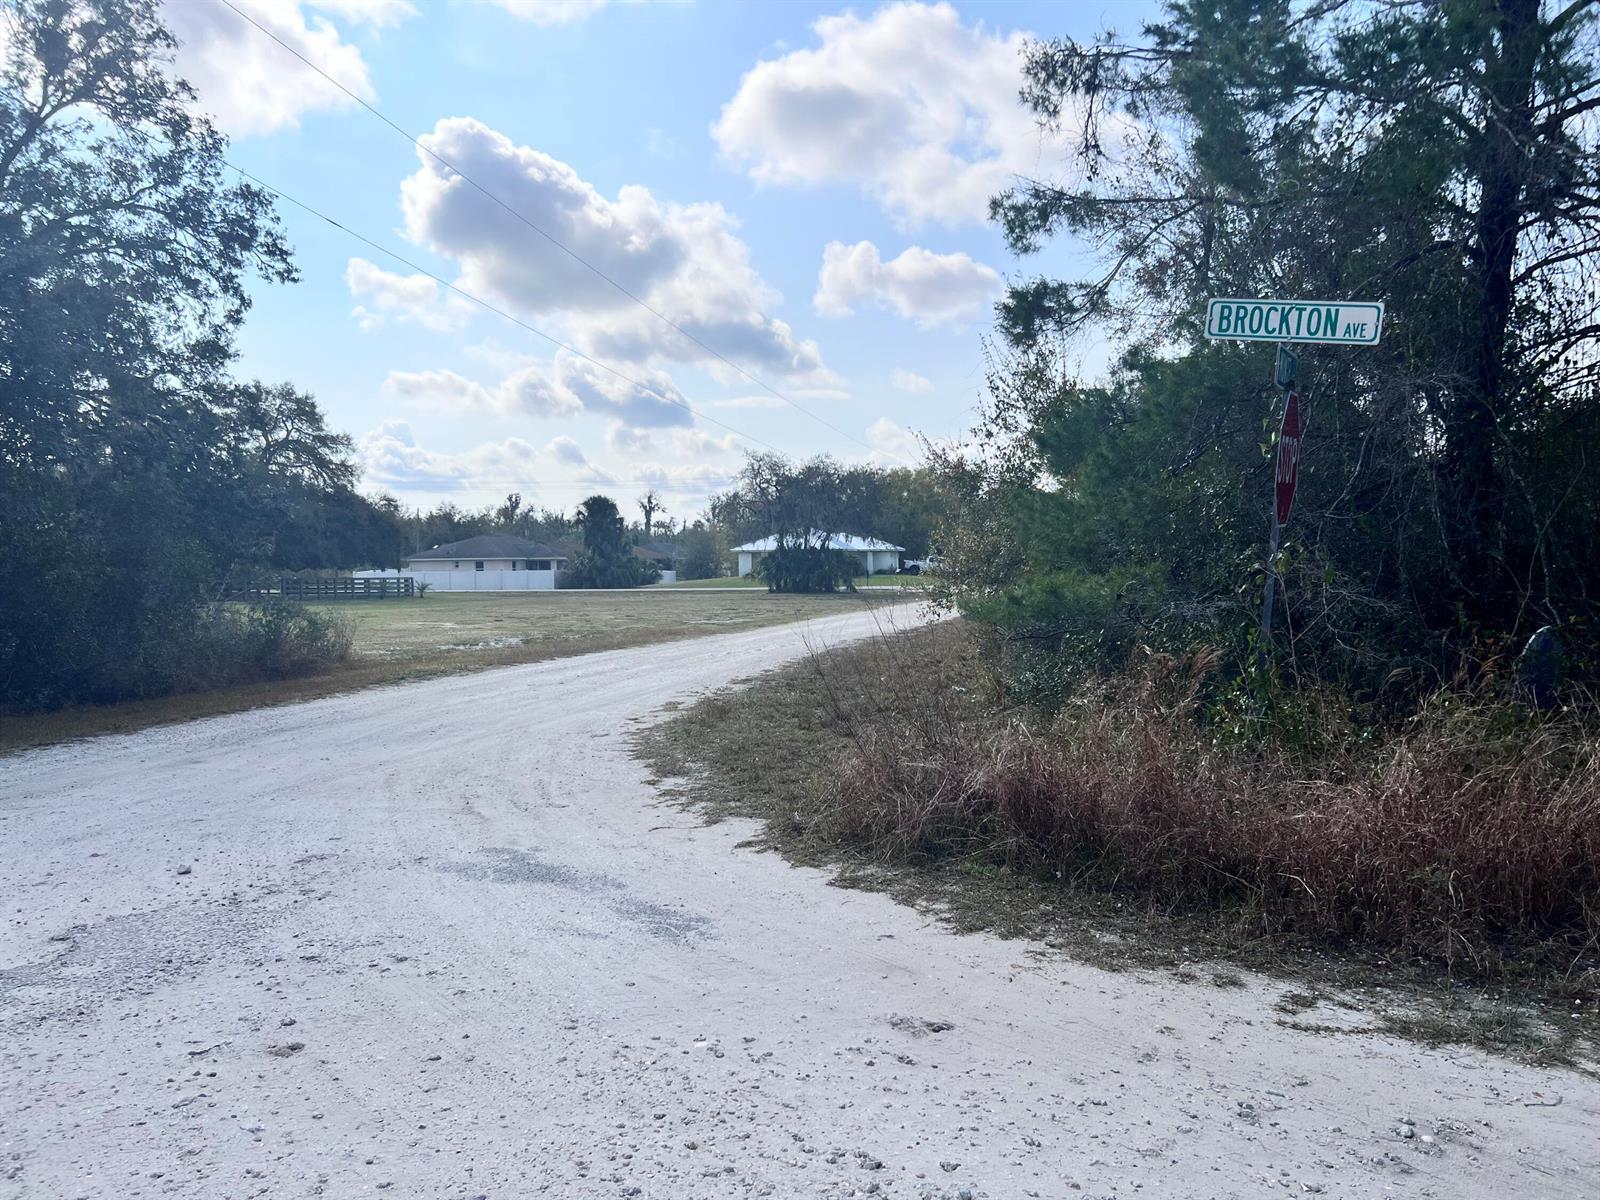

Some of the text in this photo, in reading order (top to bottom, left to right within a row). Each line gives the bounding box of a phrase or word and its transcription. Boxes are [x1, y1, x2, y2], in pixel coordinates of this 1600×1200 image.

[1217, 304, 1367, 338] BROCKTON AVE
[1278, 435, 1298, 484] STOP
